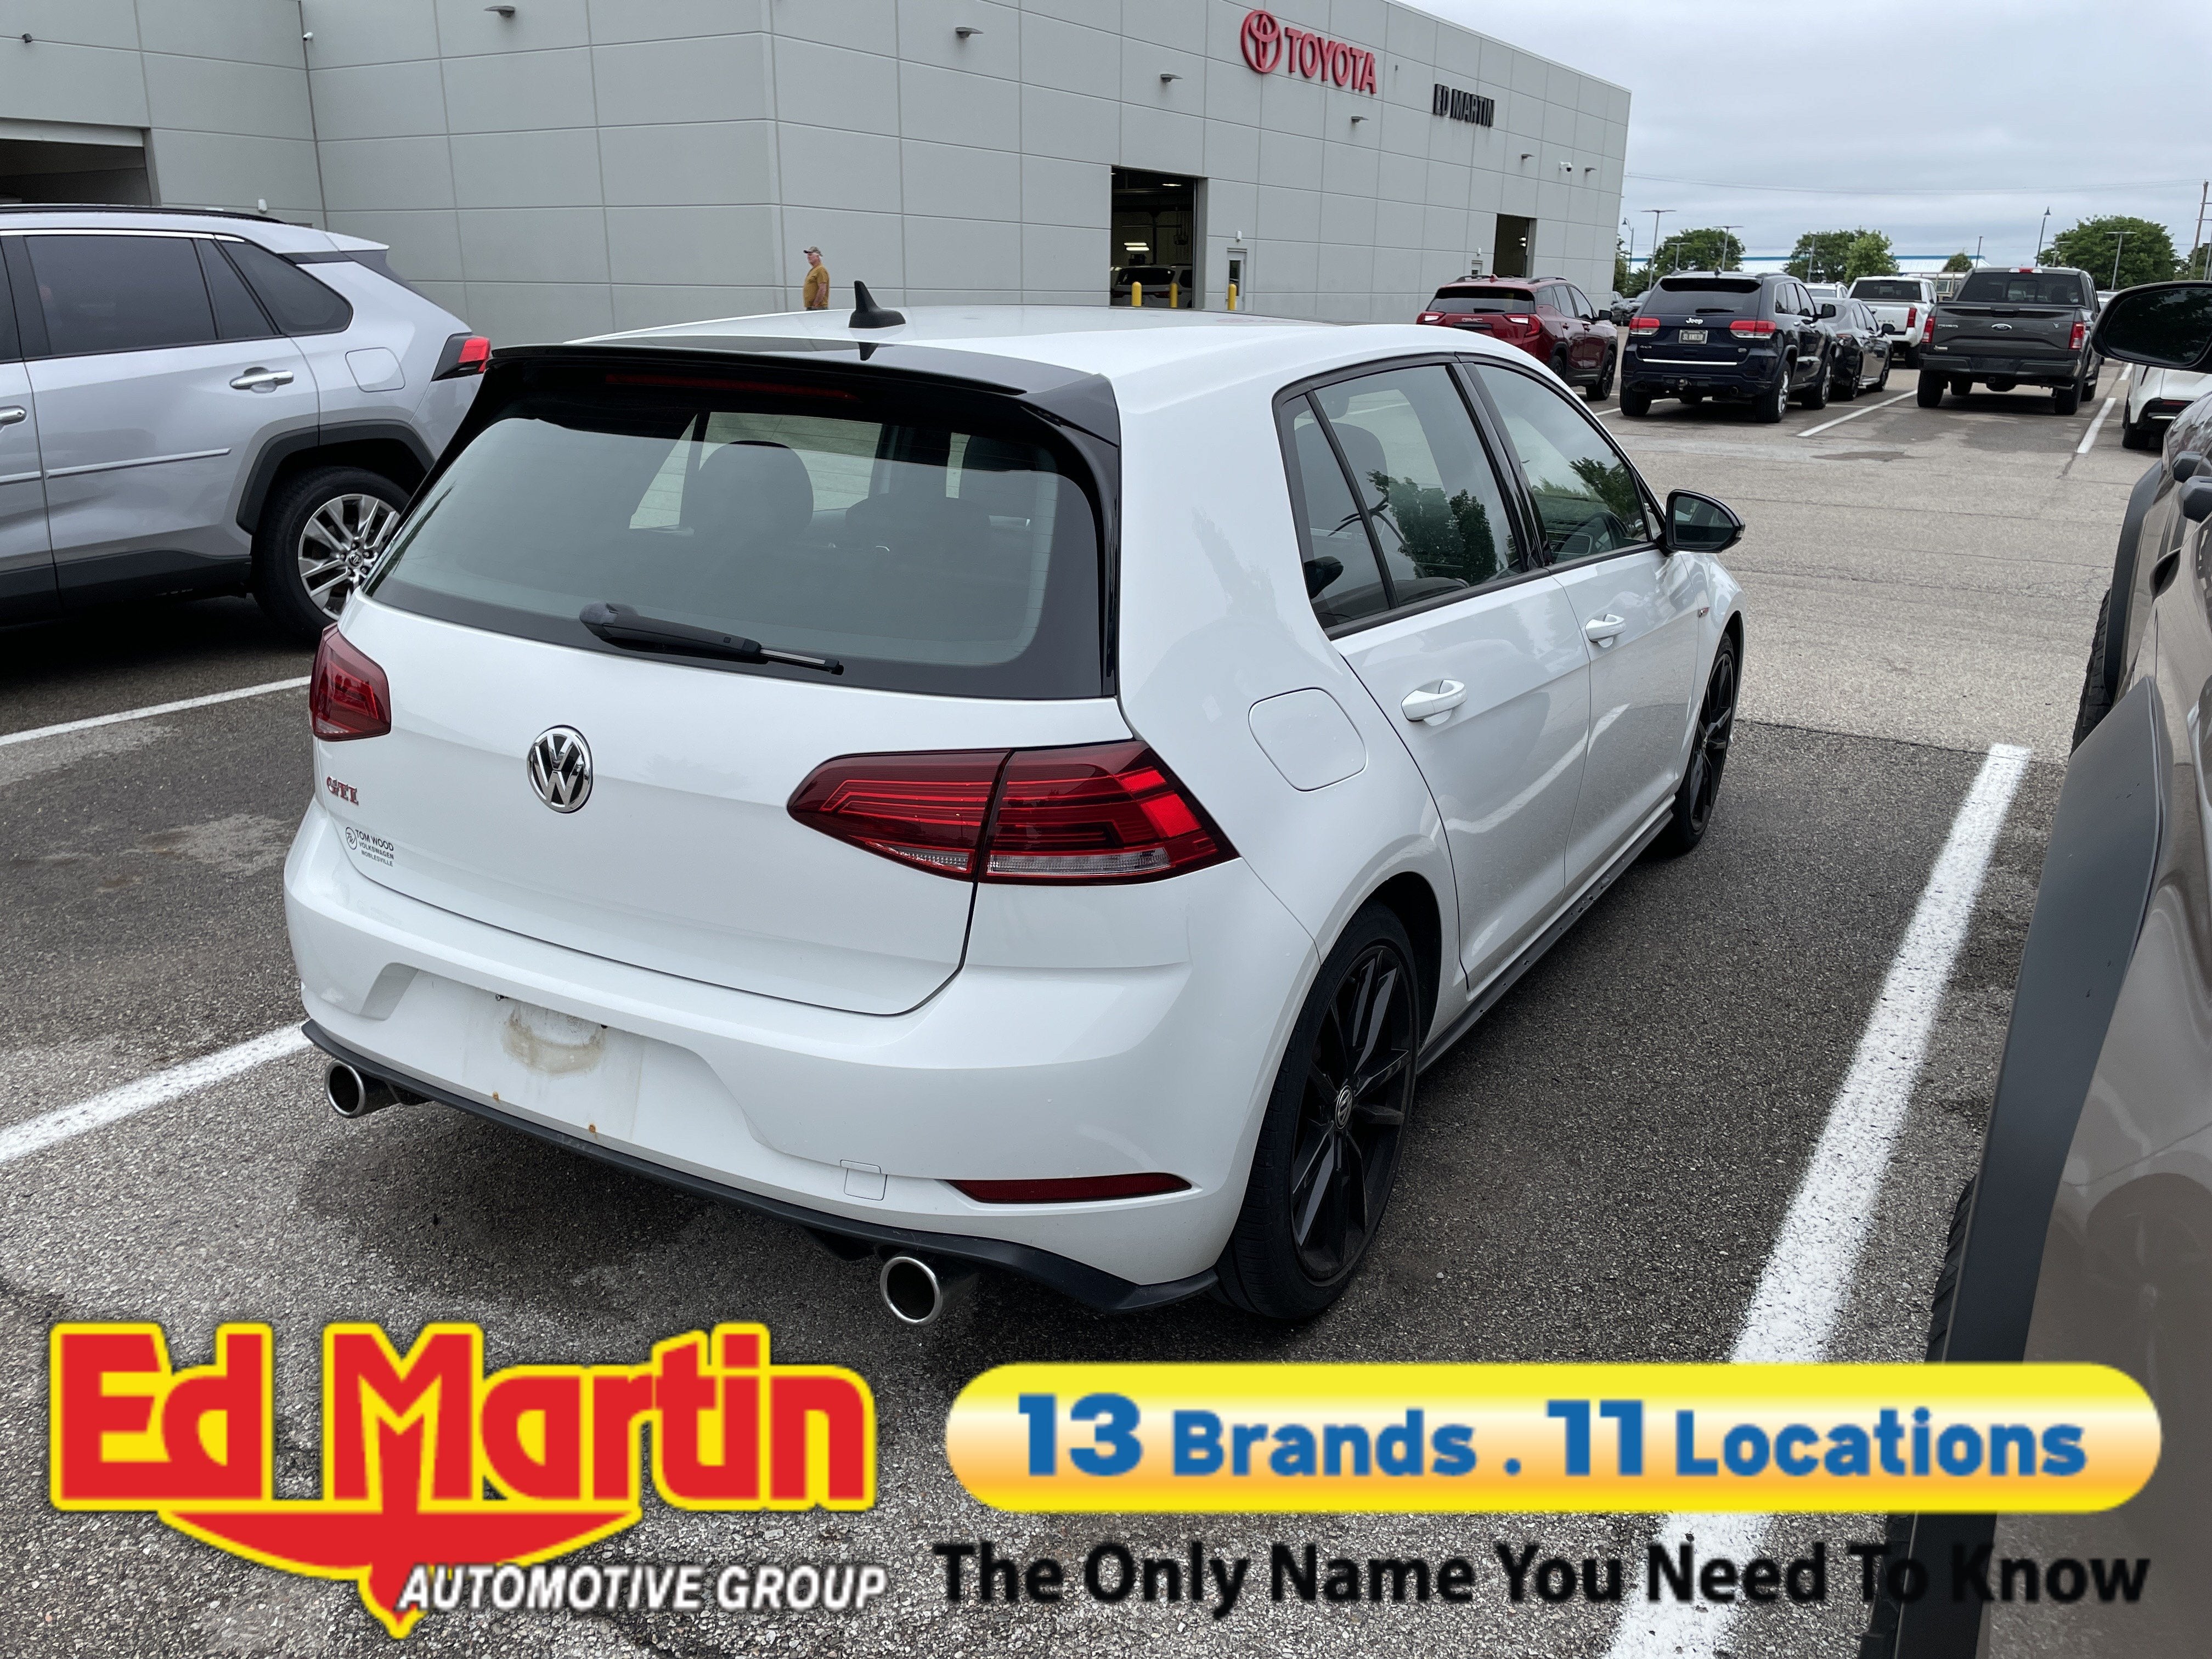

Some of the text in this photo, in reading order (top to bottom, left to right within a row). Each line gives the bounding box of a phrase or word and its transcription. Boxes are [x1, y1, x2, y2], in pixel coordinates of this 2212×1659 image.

[1285, 27, 1377, 94] TOYOTA
[1432, 84, 1494, 127] ED MARTIN
[326, 776, 359, 806] GTI
[355, 829, 394, 851] TOM WOOD
[359, 840, 394, 860] VOLKSWAGEN
[361, 849, 393, 867] NOBLESVILLE
